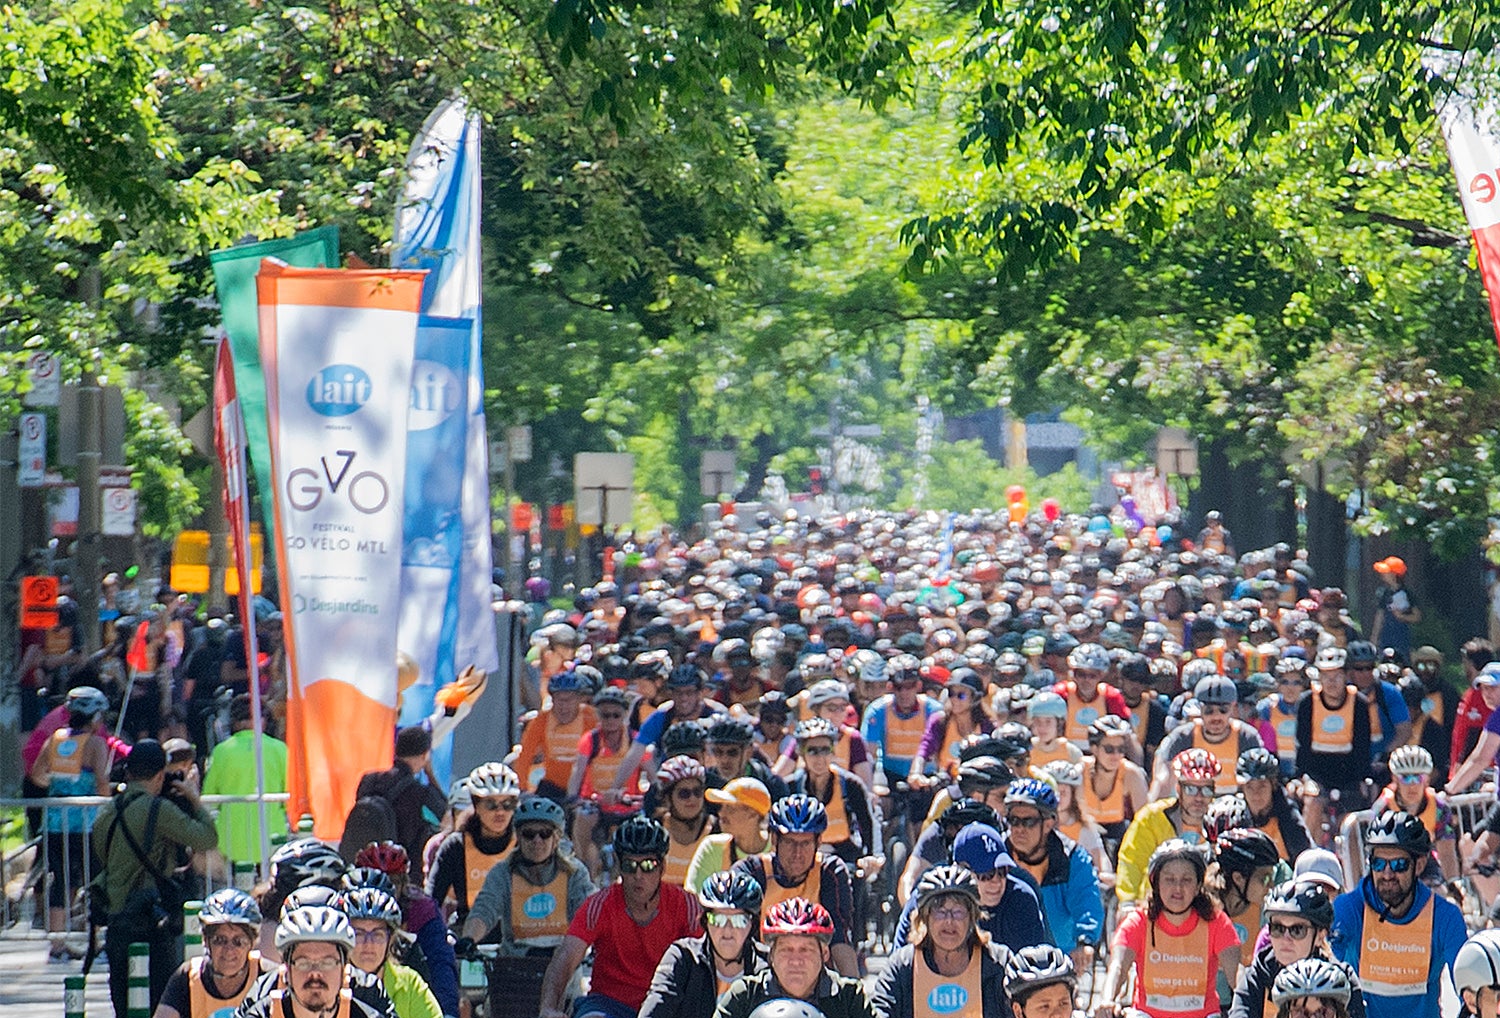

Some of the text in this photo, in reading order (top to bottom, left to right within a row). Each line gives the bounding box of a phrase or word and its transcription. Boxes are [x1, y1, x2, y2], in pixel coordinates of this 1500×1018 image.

[312, 372, 371, 404] lait
[312, 522, 355, 533] FESTIVAL
[311, 533, 350, 551] VÉLO
[357, 541, 387, 554] MTL
[310, 597, 380, 615] Desjardins
[1380, 940, 1427, 955] Desjardins
[1162, 952, 1204, 965] Desjardins
[931, 986, 967, 1008] lait
